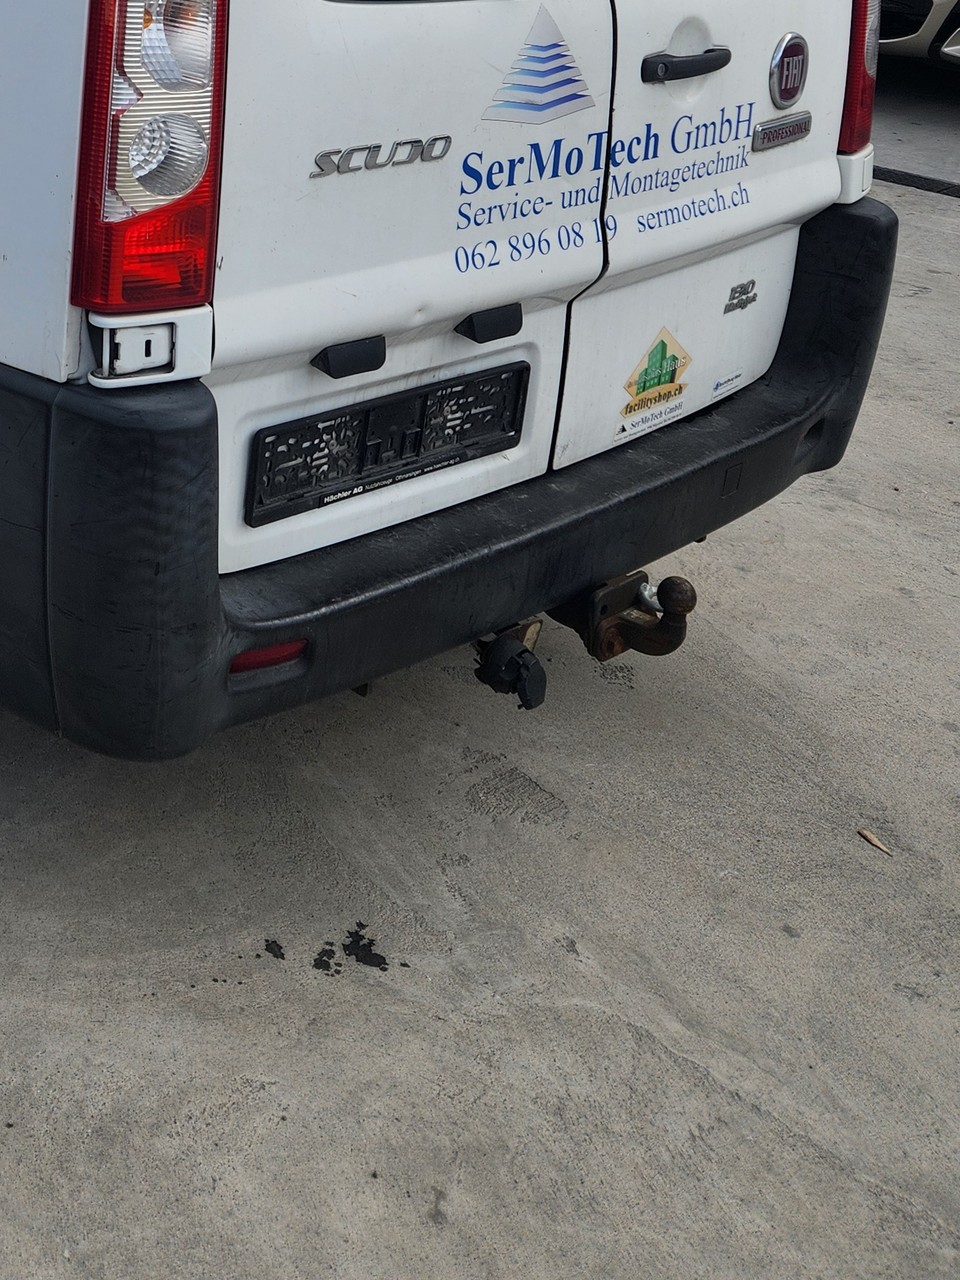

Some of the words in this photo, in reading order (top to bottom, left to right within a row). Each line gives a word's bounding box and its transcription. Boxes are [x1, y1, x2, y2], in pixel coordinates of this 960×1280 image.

[781, 54, 804, 90] FIAT
[458, 121, 660, 197] SerMoTech
[669, 101, 757, 155] GmbH
[761, 120, 811, 145] PROFESSIONAL
[309, 134, 453, 180] SCUDO
[455, 190, 553, 231] Service-
[560, 175, 601, 211] und
[608, 149, 751, 203] Montagetechnik
[453, 235, 500, 274] 062
[508, 228, 551, 263] 896
[556, 222, 585, 252] 08
[593, 213, 618, 245] 19
[636, 182, 751, 235] sermotech.ch
[323, 489, 352, 504] Hächler
[352, 485, 364, 494] AG
